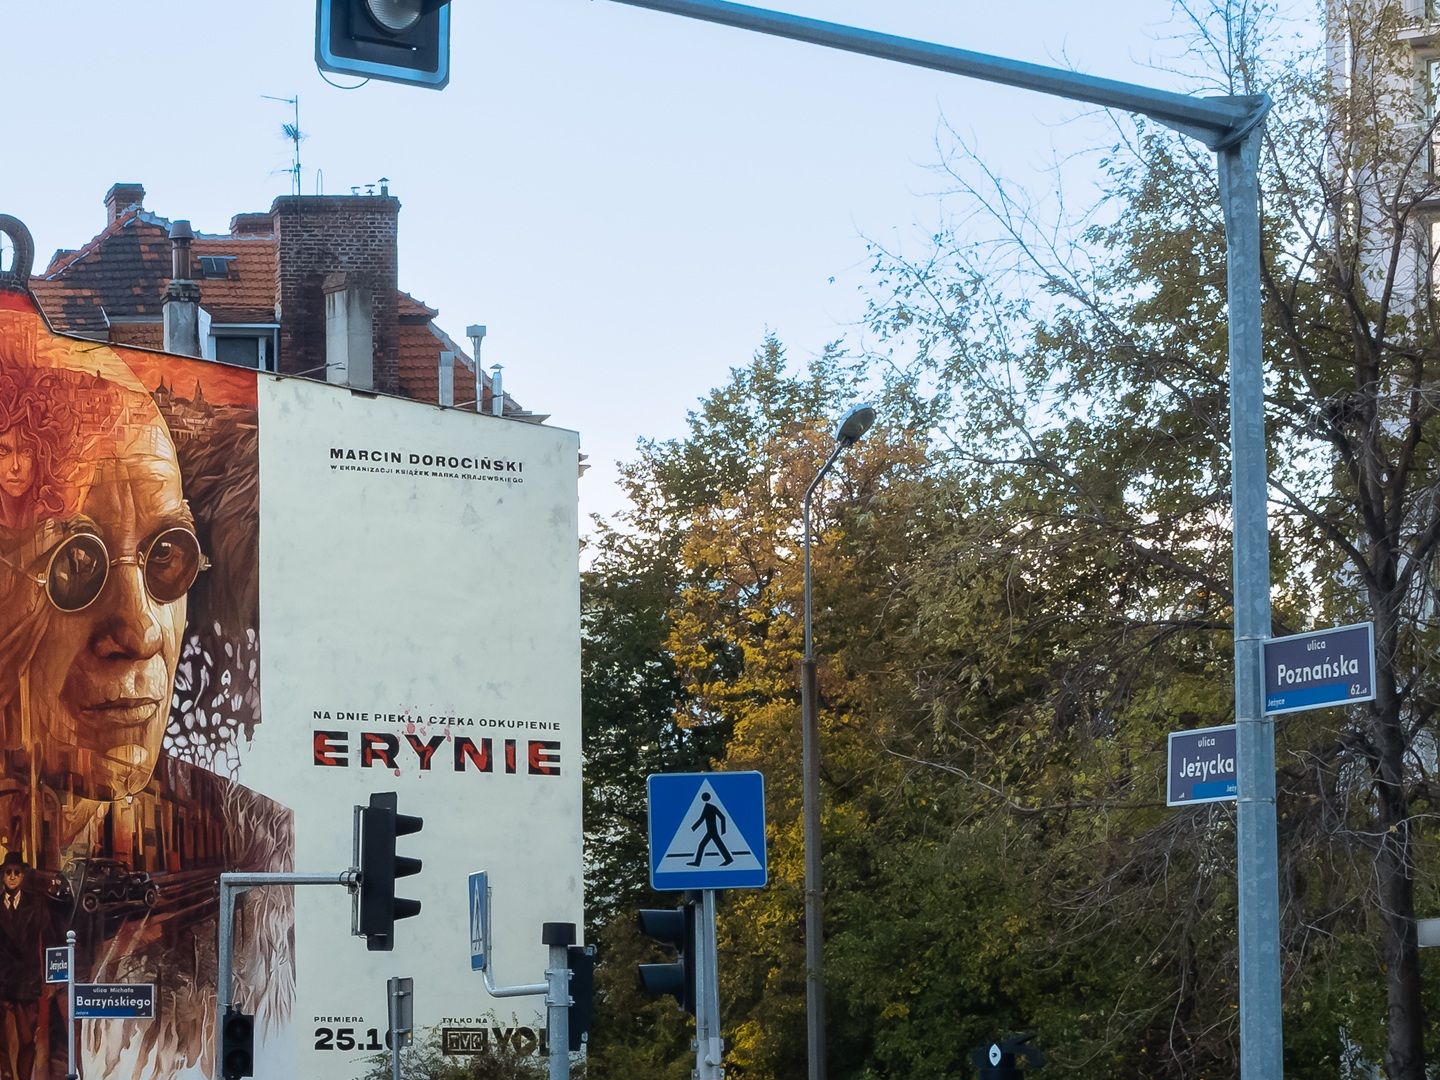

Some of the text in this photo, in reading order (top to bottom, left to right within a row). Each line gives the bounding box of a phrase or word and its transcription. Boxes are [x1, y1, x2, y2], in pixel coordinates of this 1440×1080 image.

[330, 448, 523, 473] MARCIN DOROCIŃSKI
[340, 465, 393, 474] EKRANIZACJI
[396, 468, 429, 477] KSIĄŻEK
[432, 471, 459, 479] MARKA
[461, 474, 523, 483] KRAJEWSKIEGO
[1307, 640, 1326, 651] ulica
[1277, 654, 1359, 685] Poznańska
[313, 711, 560, 730] NA DNIE PIEKŁA CZEKA ODKUPIENIE
[1197, 736, 1215, 747] ulica
[313, 730, 561, 775] ERYNIE
[1179, 753, 1234, 782] Jeżycka
[76, 996, 151, 1009] Barzyńskiego
